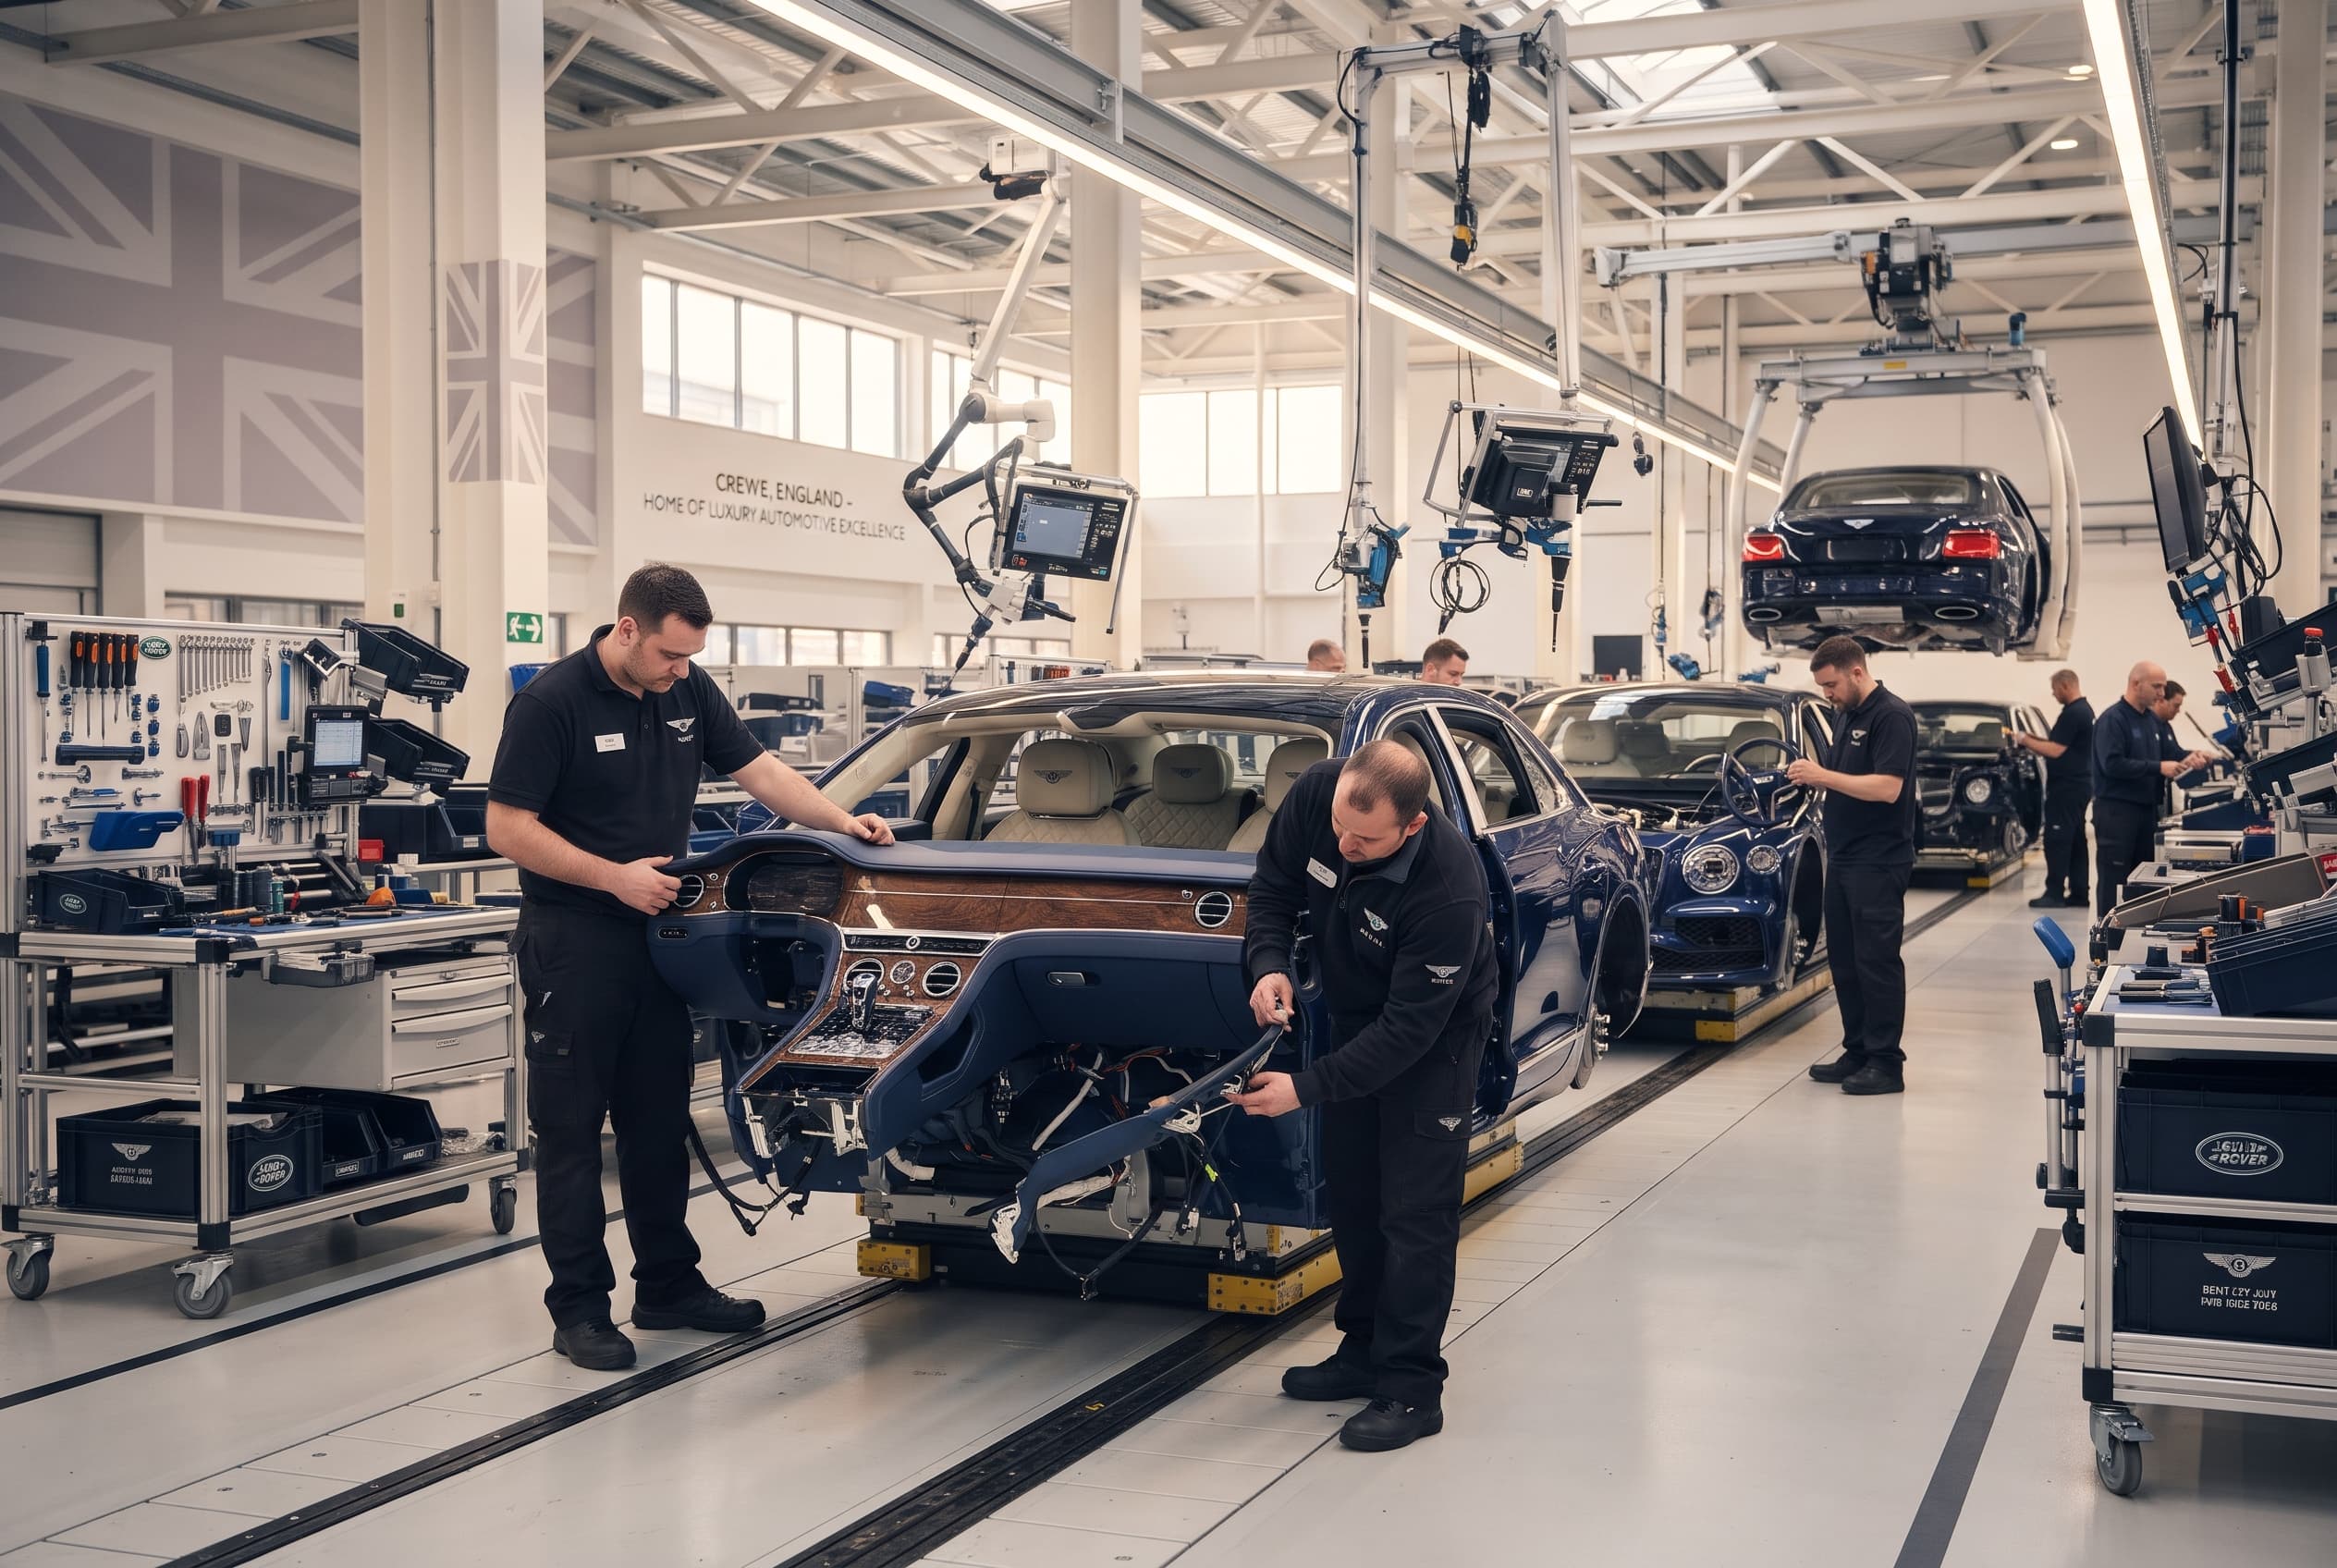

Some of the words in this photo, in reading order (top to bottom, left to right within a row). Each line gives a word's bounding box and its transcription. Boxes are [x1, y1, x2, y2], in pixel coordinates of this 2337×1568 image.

[716, 472, 773, 501] CREWE,
[777, 483, 843, 508] ENGLAND
[643, 493, 683, 514] HOME
[687, 498, 705, 515] OF
[708, 501, 756, 522] LUXURY
[760, 508, 837, 533] AUTOMOTIVE
[839, 519, 905, 541] EXCELLENCE
[2203, 1285, 2230, 1296] BENT
